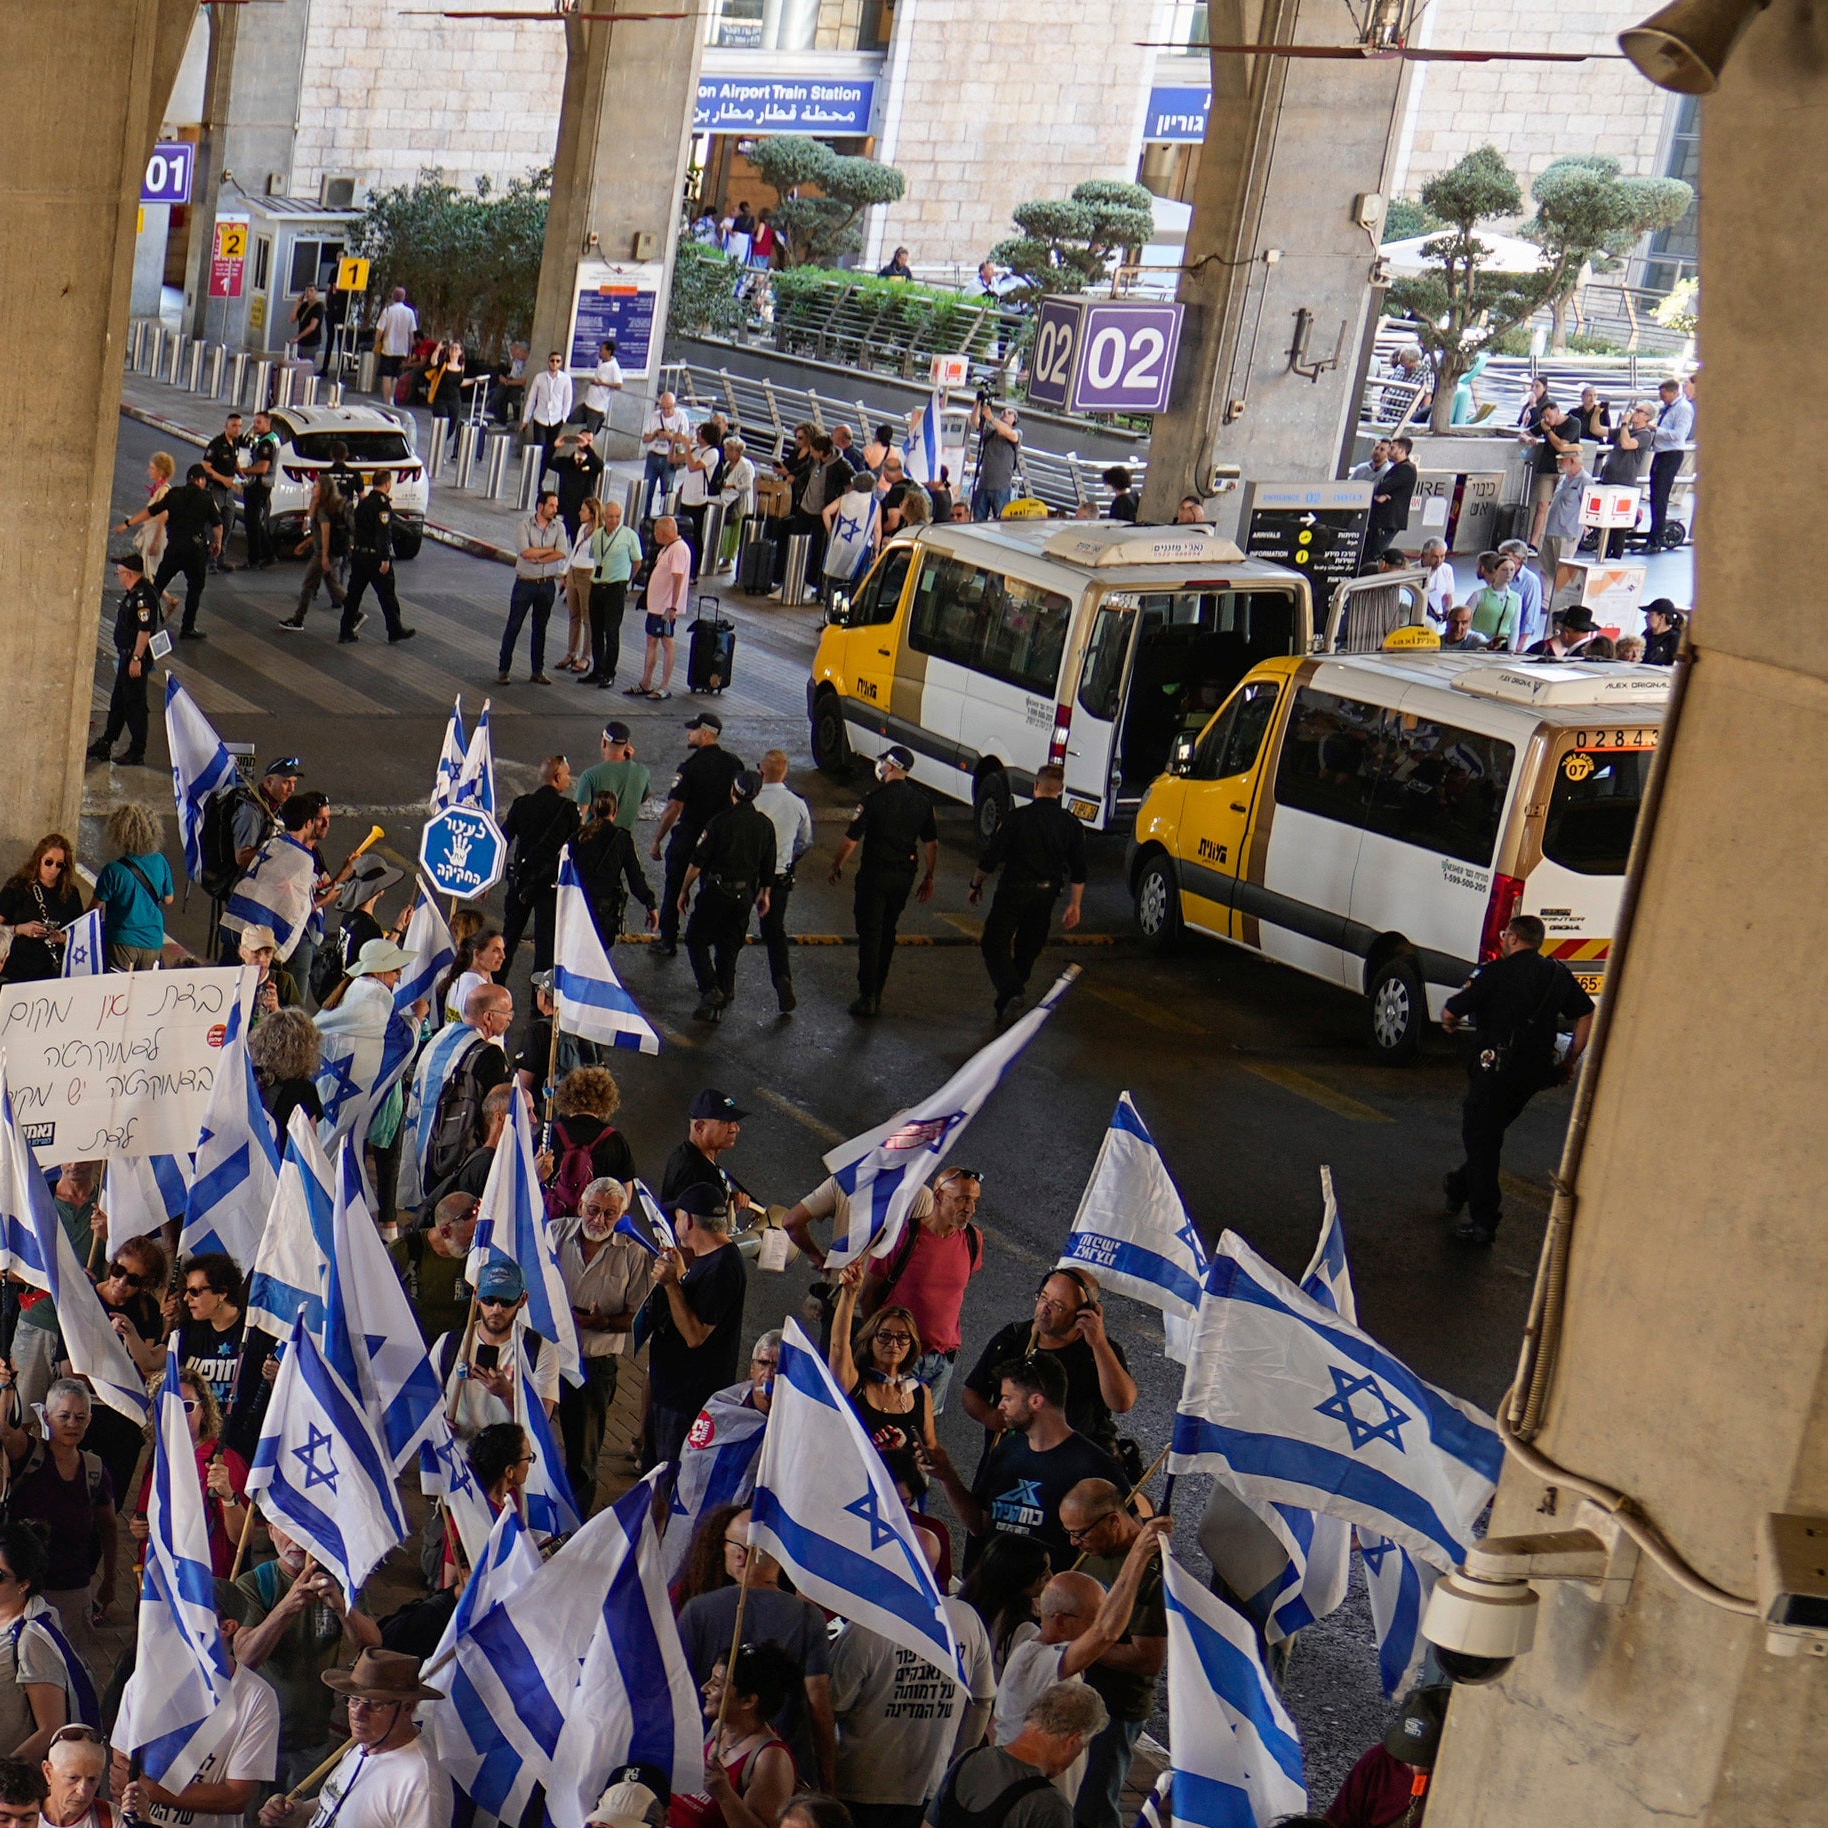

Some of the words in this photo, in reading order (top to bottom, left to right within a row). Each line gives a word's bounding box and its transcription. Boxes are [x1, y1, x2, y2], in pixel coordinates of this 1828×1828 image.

[720, 84, 770, 101] Airport
[772, 85, 807, 99] Train
[810, 85, 861, 101] Station
[712, 102, 755, 123] مطار
[801, 104, 856, 122] محطة
[1156, 115, 1205, 136] גוריון
[146, 155, 184, 193] 01
[228, 234, 241, 254] 2
[348, 264, 359, 284] 1
[1036, 320, 1072, 386] 02
[1088, 327, 1165, 390] 02
[1306, 491, 1321, 503] 02
[1473, 483, 1496, 497] כיבוי
[1470, 502, 1489, 516] אש
[1252, 531, 1281, 541] ARRIVALS
[1249, 550, 1289, 560] INFORMATION
[1605, 681, 1629, 690] ALEX
[1569, 762, 1587, 778] 07
[445, 814, 487, 841] לעצור
[437, 861, 481, 887] החקיקה
[9, 998, 74, 1035] מקום
[96, 994, 130, 1032] אין
[43, 1026, 163, 1072] לדמוקרטיה
[109, 1064, 215, 1108] בדמוקרטיה
[76, 1116, 136, 1151] לדת
[894, 1683, 938, 1701] דמותה
[940, 1684, 956, 1700] על
[885, 1700, 936, 1720] המדינה
[937, 1702, 954, 1719] של
